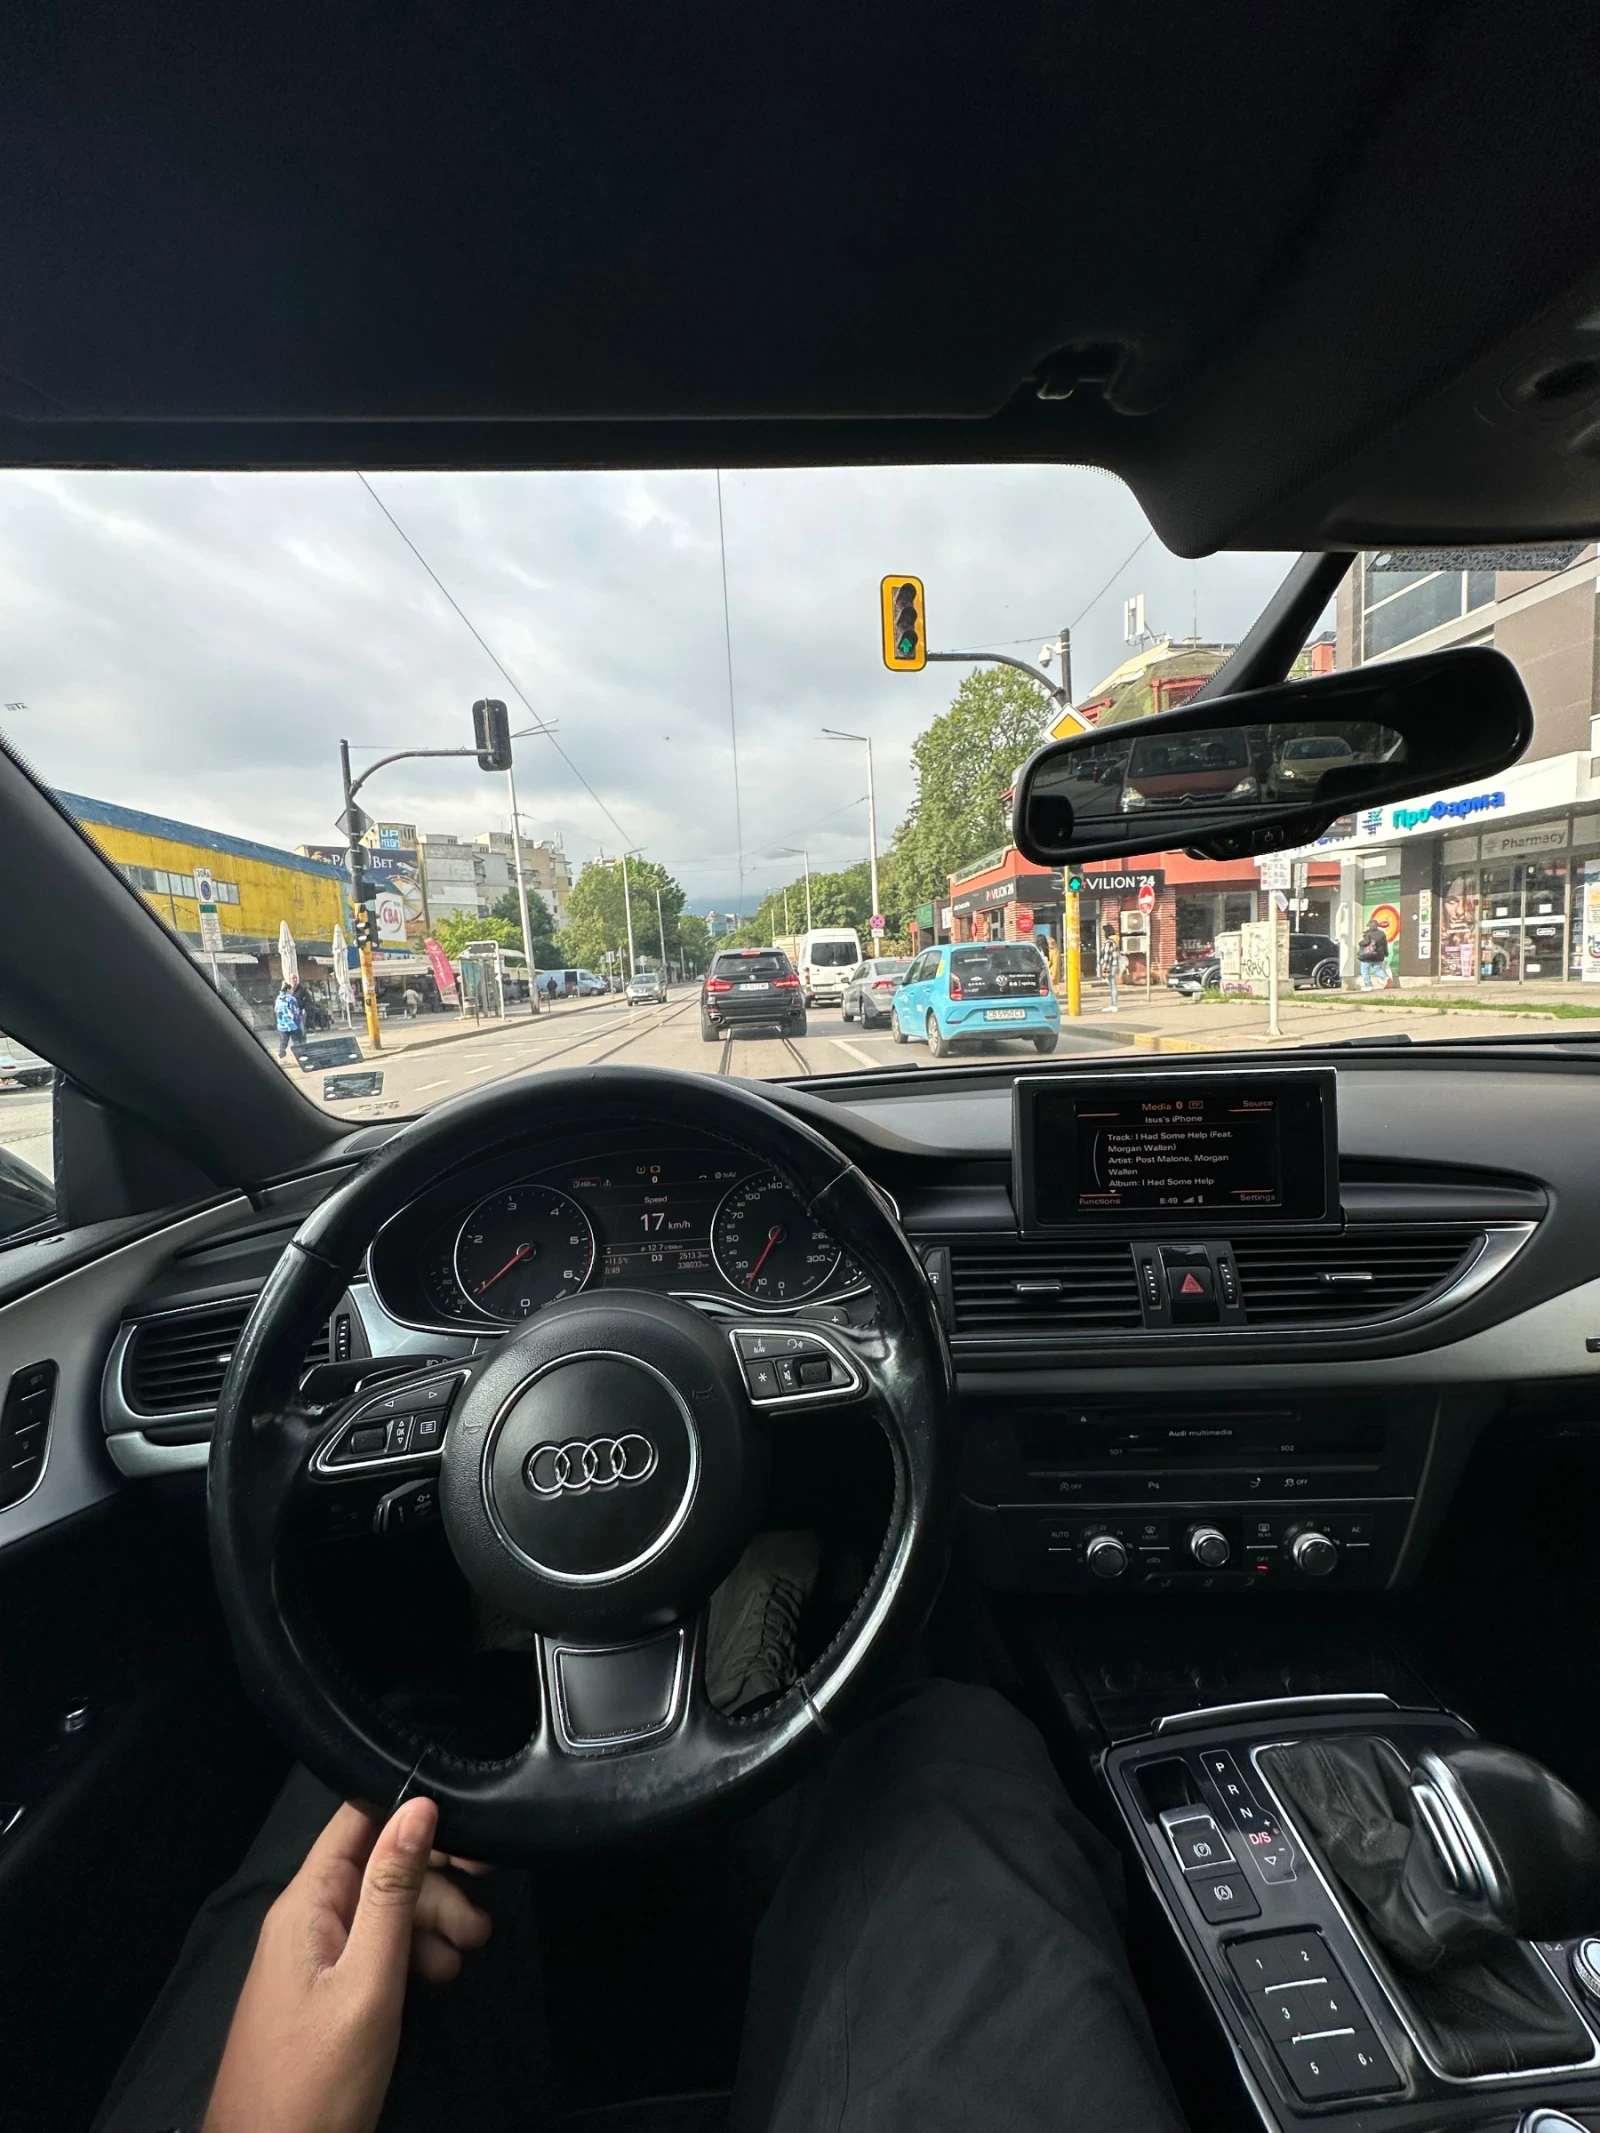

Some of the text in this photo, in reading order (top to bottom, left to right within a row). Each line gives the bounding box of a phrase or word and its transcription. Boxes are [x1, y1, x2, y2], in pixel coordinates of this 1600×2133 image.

[1393, 791, 1505, 830] ПроФарма
[380, 828, 399, 838] UP
[1502, 831, 1565, 850] Pharmacy
[372, 856, 394, 869] BET
[383, 907, 399, 924] CBA
[1142, 1103, 1172, 1111] Media
[1243, 1100, 1273, 1108] Source
[1161, 1132, 1185, 1140] Some
[1188, 1131, 1208, 1140] Help
[1210, 1130, 1233, 1138] (Feat.
[1108, 1143, 1176, 1154] Morgan Wallen)
[1194, 1154, 1229, 1163] Morgan
[1167, 1178, 1192, 1186] Some
[1194, 1178, 1214, 1186] Help
[644, 1196, 668, 1204] Speed
[1240, 1194, 1276, 1202] Settings
[640, 1212, 691, 1231] 17 km/h
[474, 1235, 483, 1243] 2
[570, 1236, 579, 1244] 5
[563, 1270, 573, 1278] 6
[520, 1299, 530, 1307] 0
[397, 1428, 405, 1436] OK
[1189, 1428, 1233, 1436] multimedia
[1216, 1762, 1225, 1774] P
[1228, 1784, 1240, 1795] R
[1240, 1808, 1254, 1819] N
[1249, 1831, 1272, 1845] D/S
[1301, 1951, 1310, 1962] 2
[1256, 1958, 1263, 1969] 1
[1329, 2000, 1338, 2012] 4
[1282, 2007, 1291, 2020] 3
[1358, 2053, 1367, 2066] 6
[1311, 2062, 1319, 2075] 5
